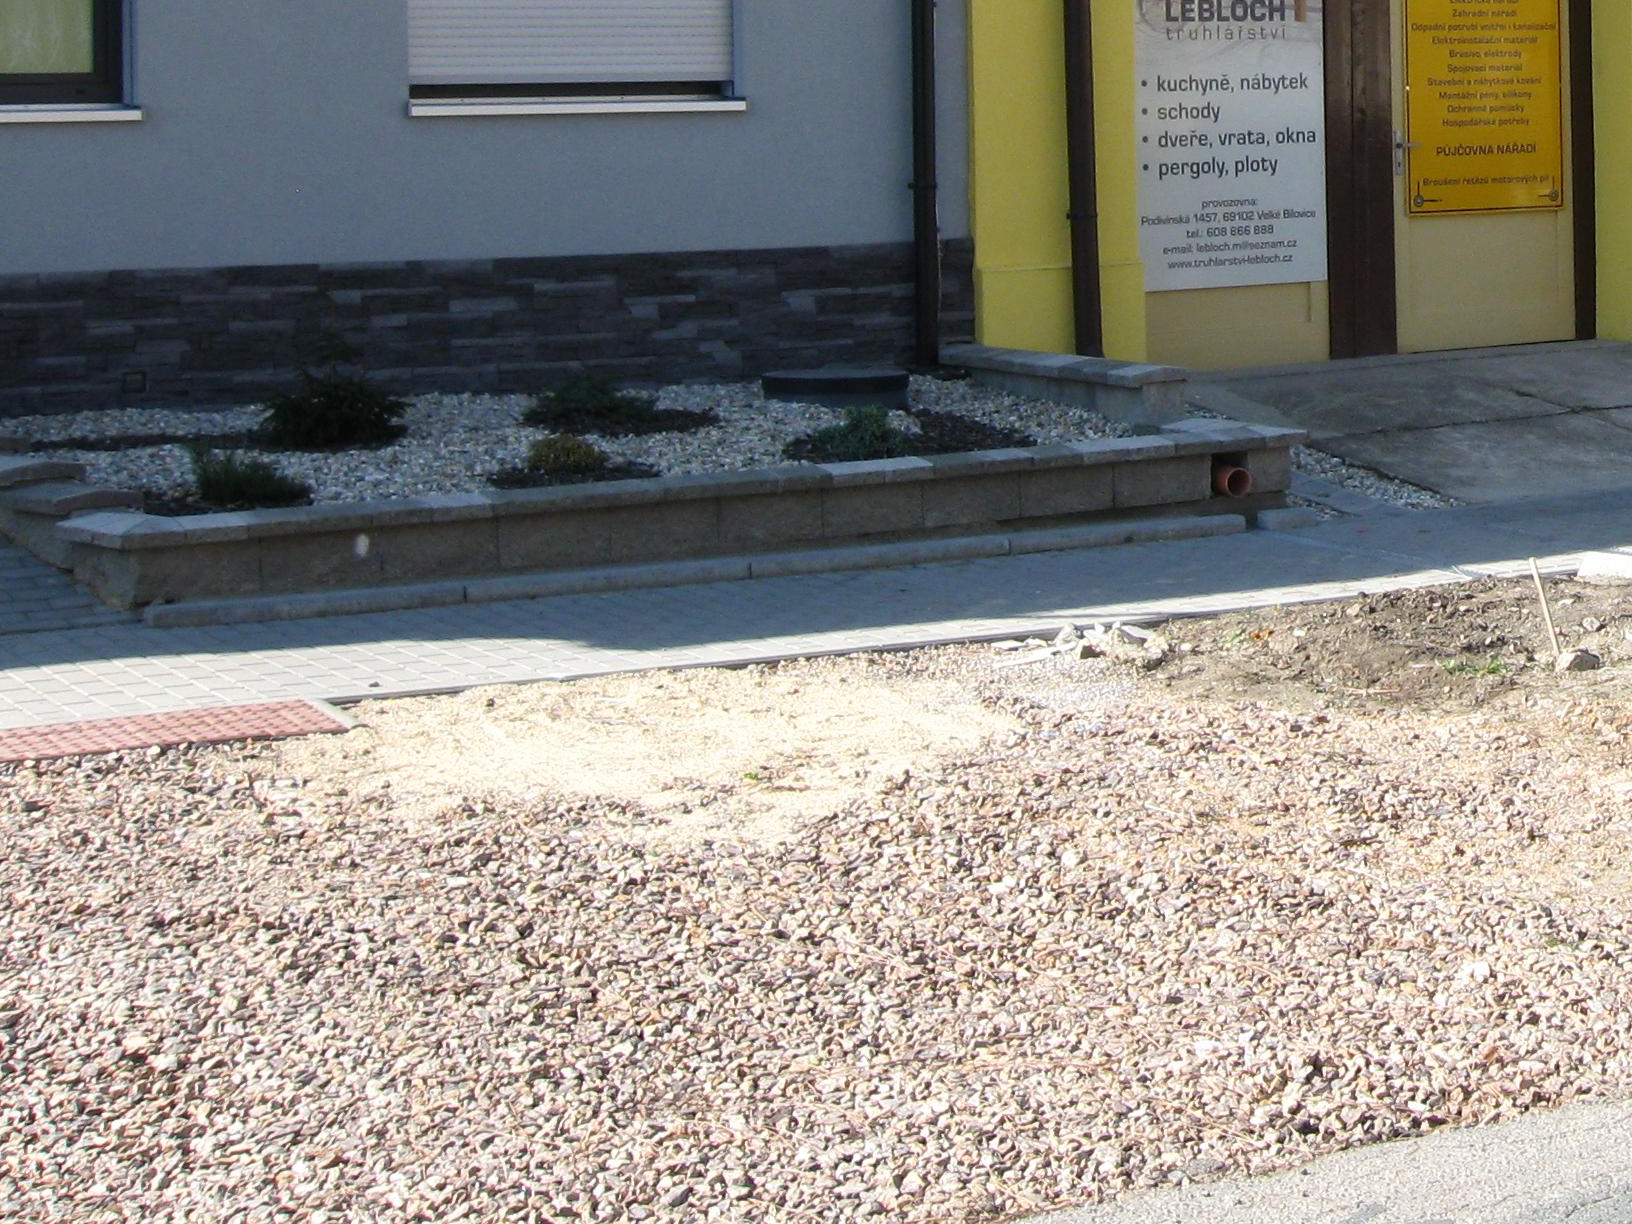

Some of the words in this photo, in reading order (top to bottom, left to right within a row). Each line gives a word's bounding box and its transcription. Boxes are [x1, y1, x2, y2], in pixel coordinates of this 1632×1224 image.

[1157, 74, 1235, 96] kuchyně,
[1240, 72, 1308, 94] nábytek
[1157, 102, 1221, 123] schody
[1158, 130, 1213, 148] dveře,
[1218, 129, 1270, 147] vrata,
[1275, 127, 1316, 144] okna
[1159, 156, 1229, 180] pergoly,
[1234, 155, 1278, 177] ploty
[1223, 211, 1255, 222] 69102
